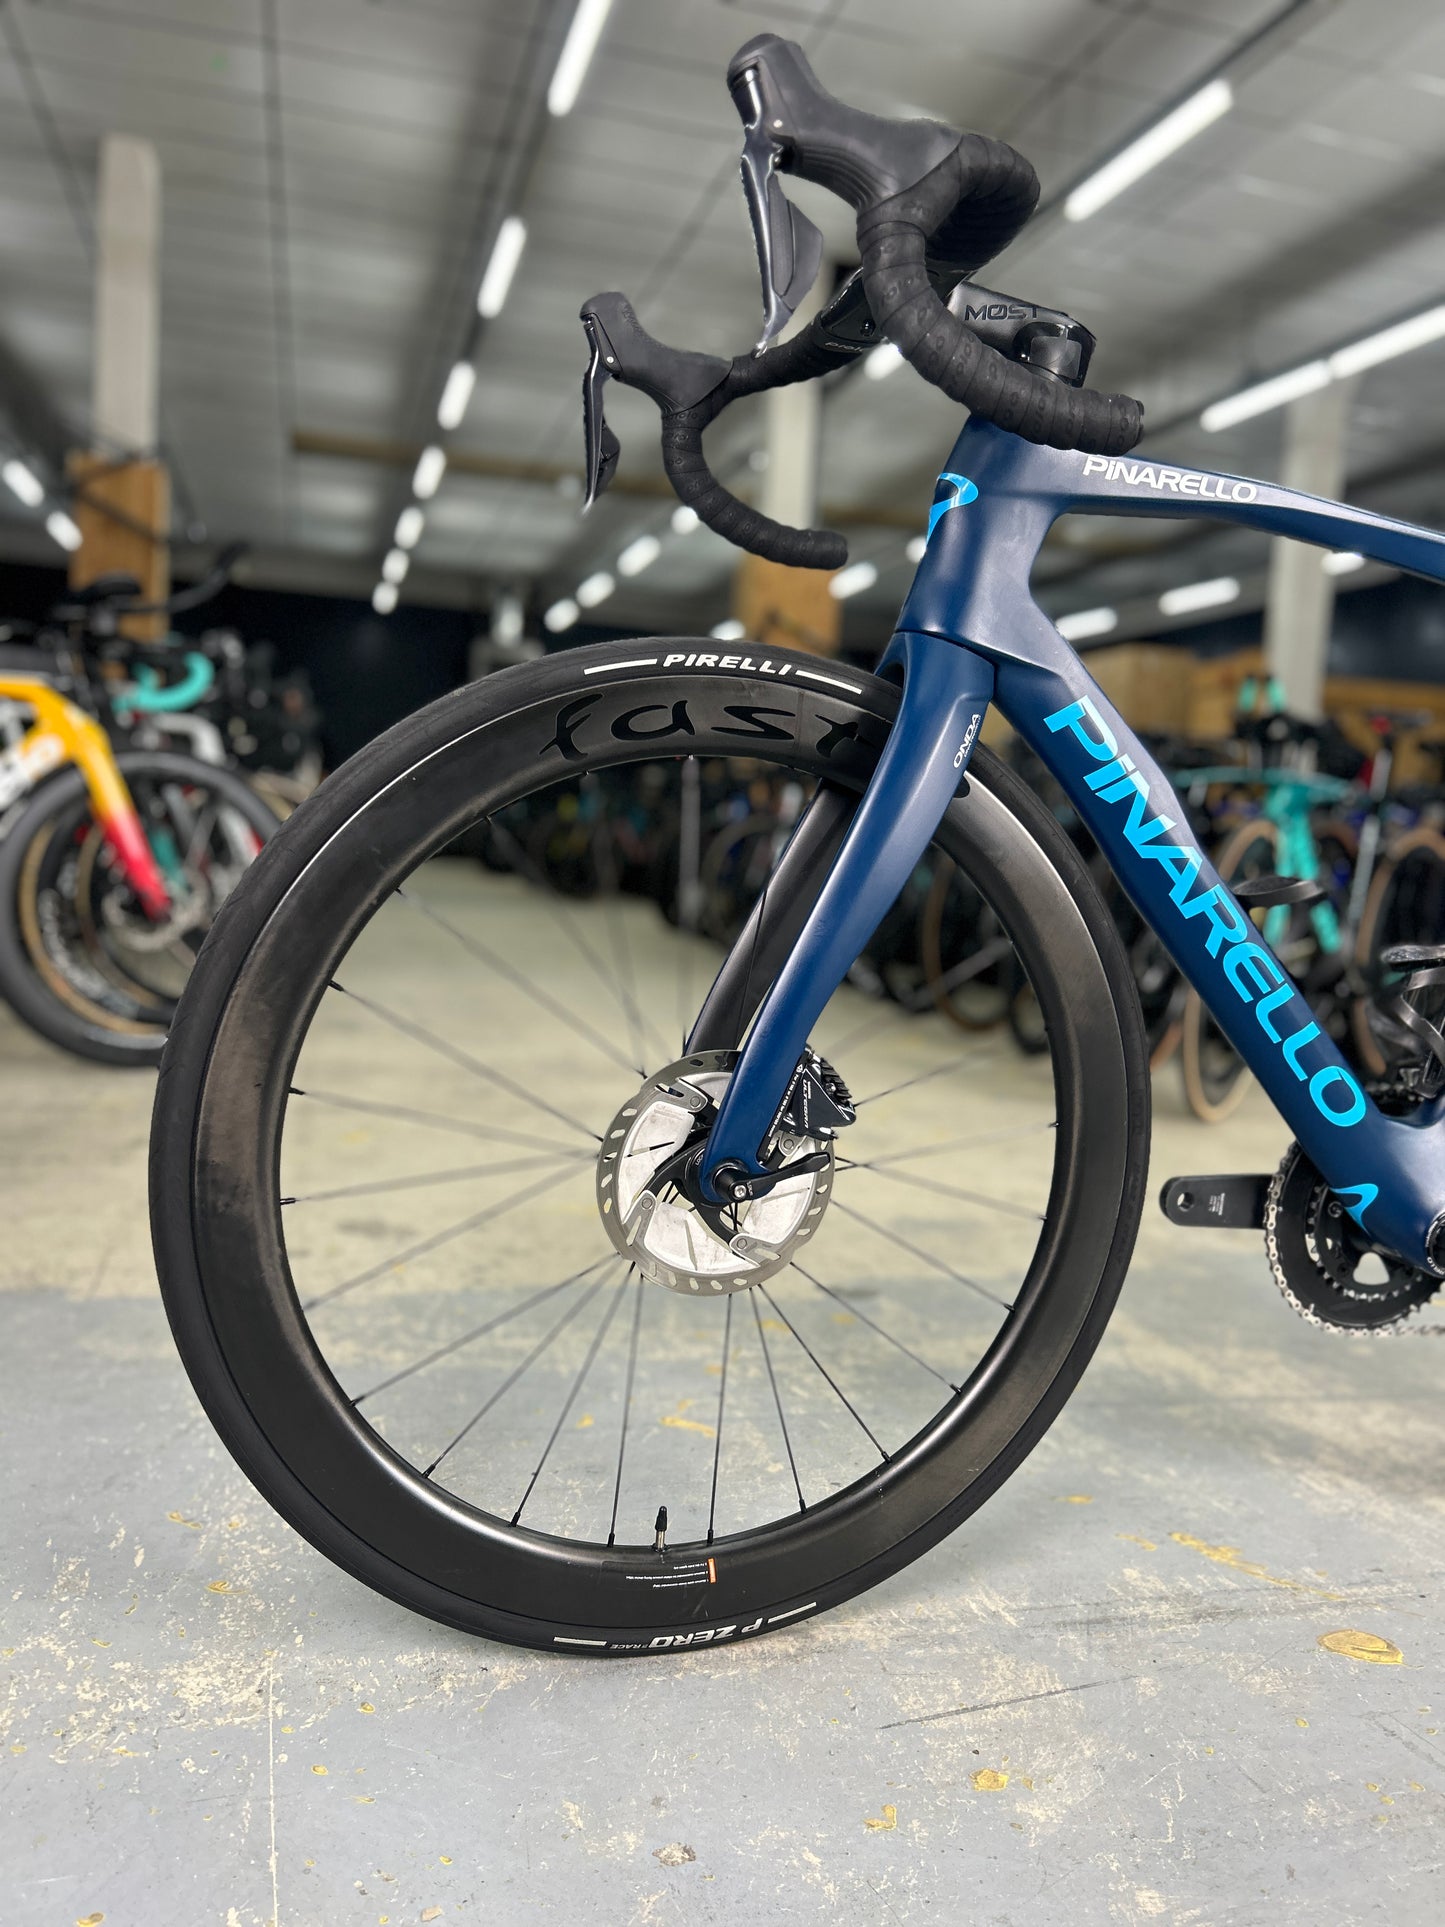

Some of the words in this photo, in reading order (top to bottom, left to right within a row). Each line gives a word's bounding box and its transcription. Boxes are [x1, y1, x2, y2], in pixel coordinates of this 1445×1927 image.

[663, 653, 791, 676] PIRELLI
[953, 714, 980, 768] ONDA
[649, 1625, 737, 1648] ZERO
[741, 1617, 763, 1634] P
